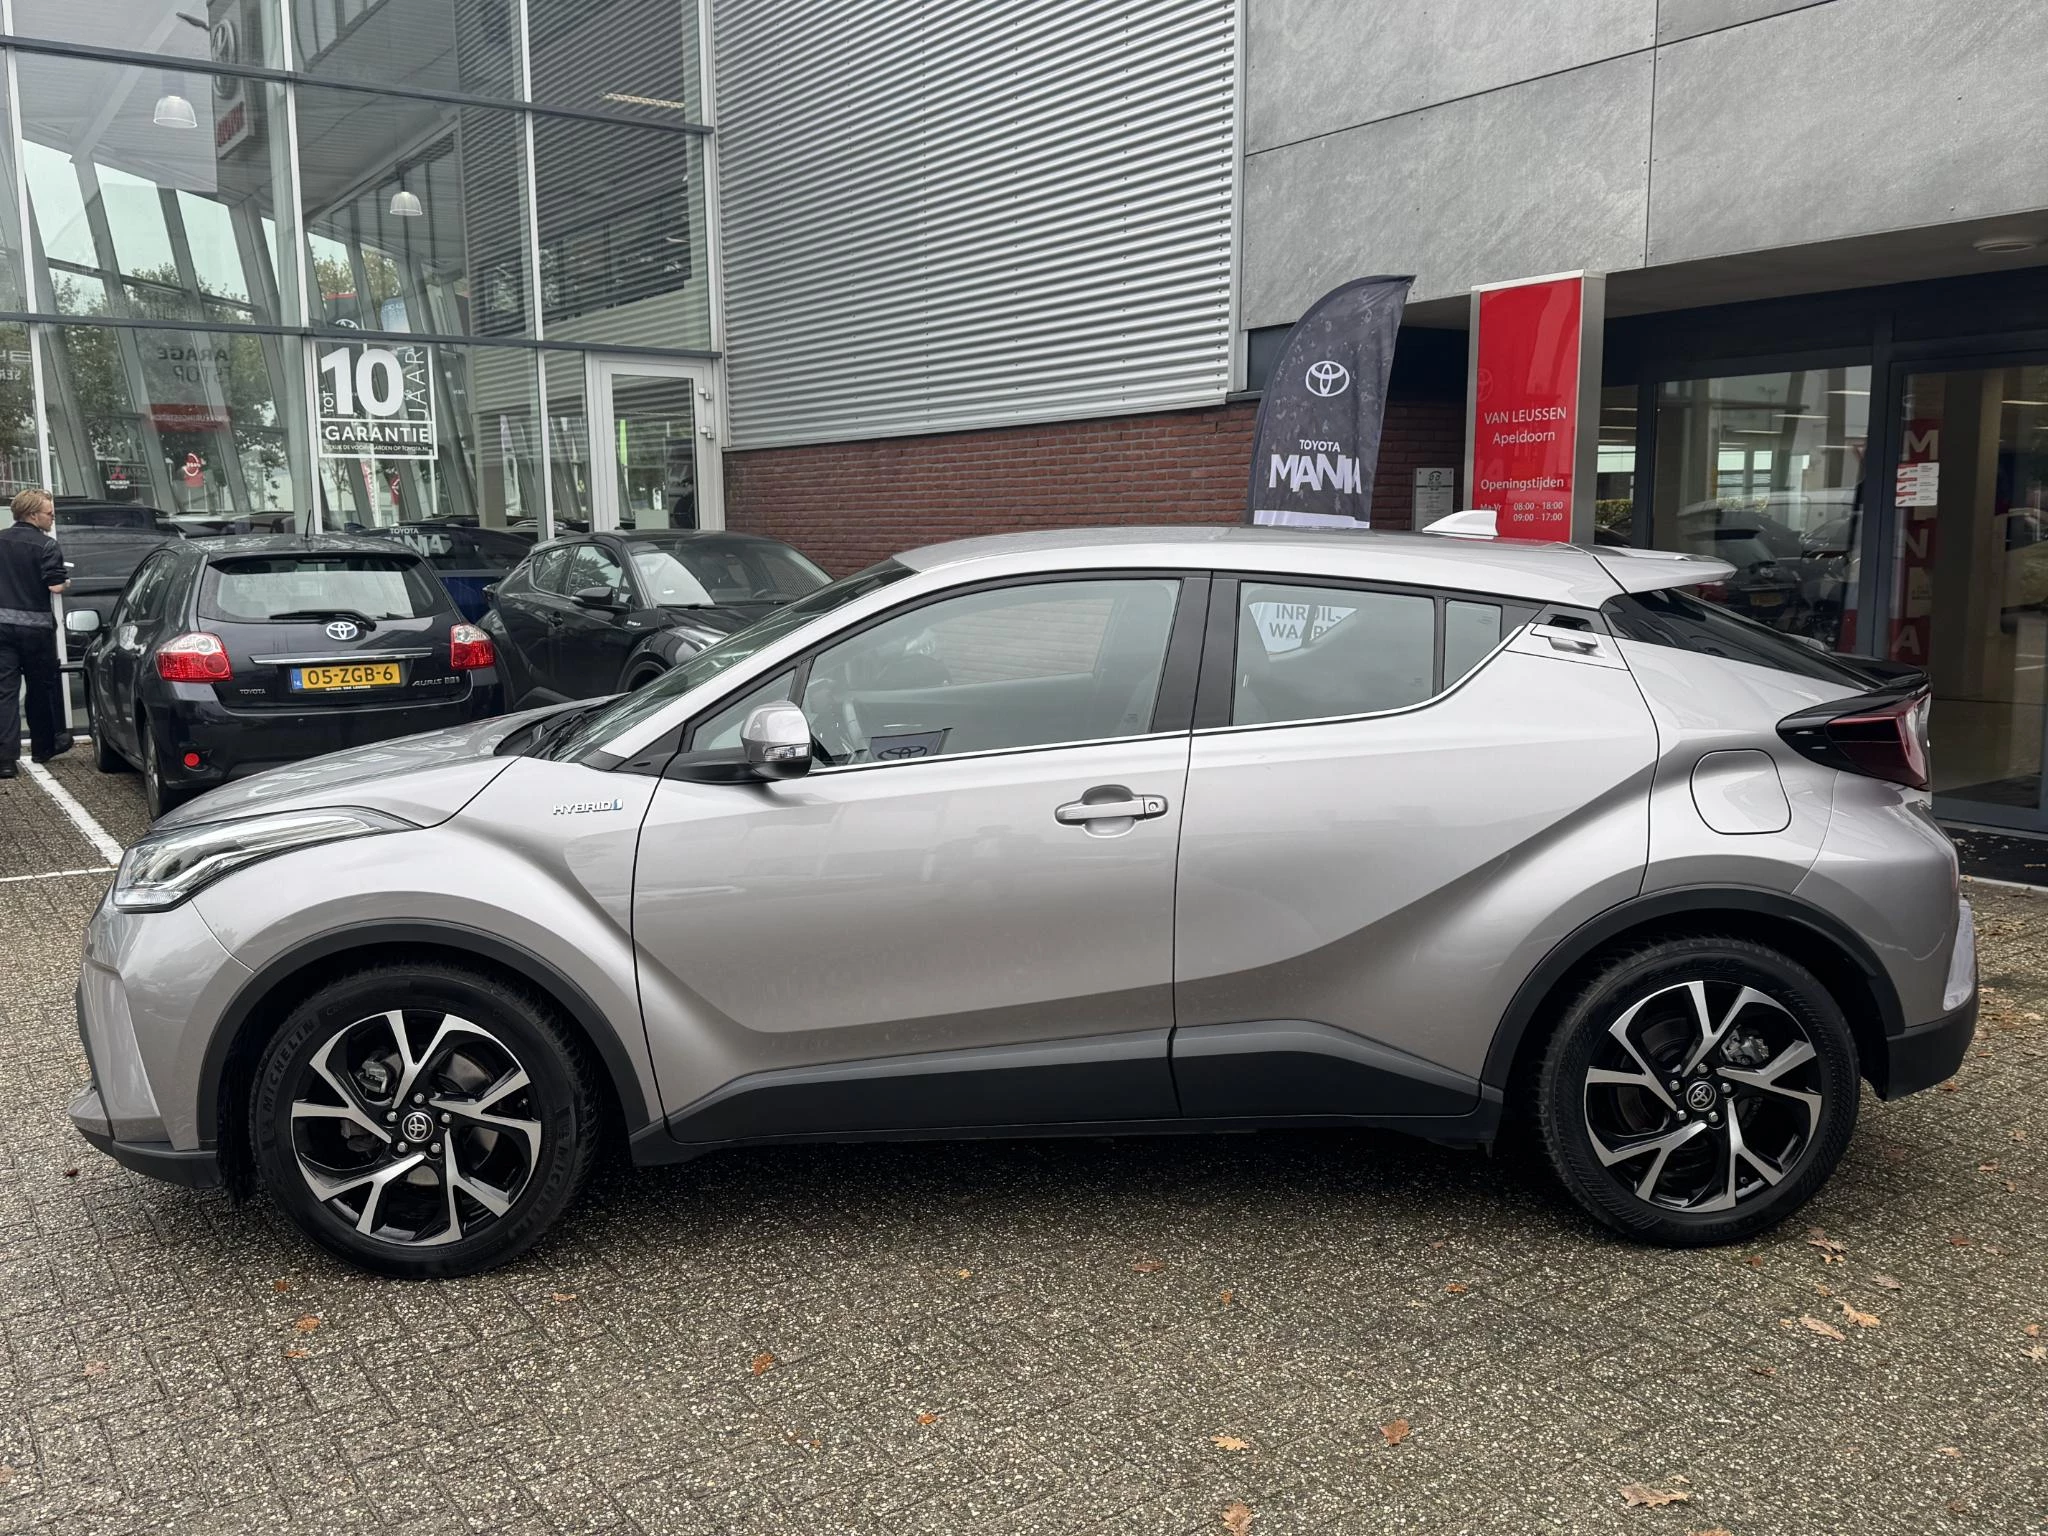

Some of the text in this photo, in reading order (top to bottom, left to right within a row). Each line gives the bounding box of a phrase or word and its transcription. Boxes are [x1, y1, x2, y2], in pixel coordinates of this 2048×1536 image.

[320, 347, 405, 417] 10
[405, 350, 427, 419] JAAR
[322, 391, 335, 414] TOT
[1484, 407, 1567, 424] VAN LEUSSEN
[325, 426, 429, 442] GARANTIE
[1492, 431, 1556, 446] Apeldoorn
[1300, 440, 1341, 452] TOYOTA
[1481, 477, 1564, 492] Openingstijden
[1513, 502, 1535, 511] 08:00
[1542, 501, 1564, 510] 18:00
[1513, 513, 1534, 522] 09:00
[1541, 512, 1563, 521] 17:00
[307, 667, 393, 685] 05-ZGB-6
[411, 678, 443, 687] AURIS
[553, 801, 612, 815] HYBRID
